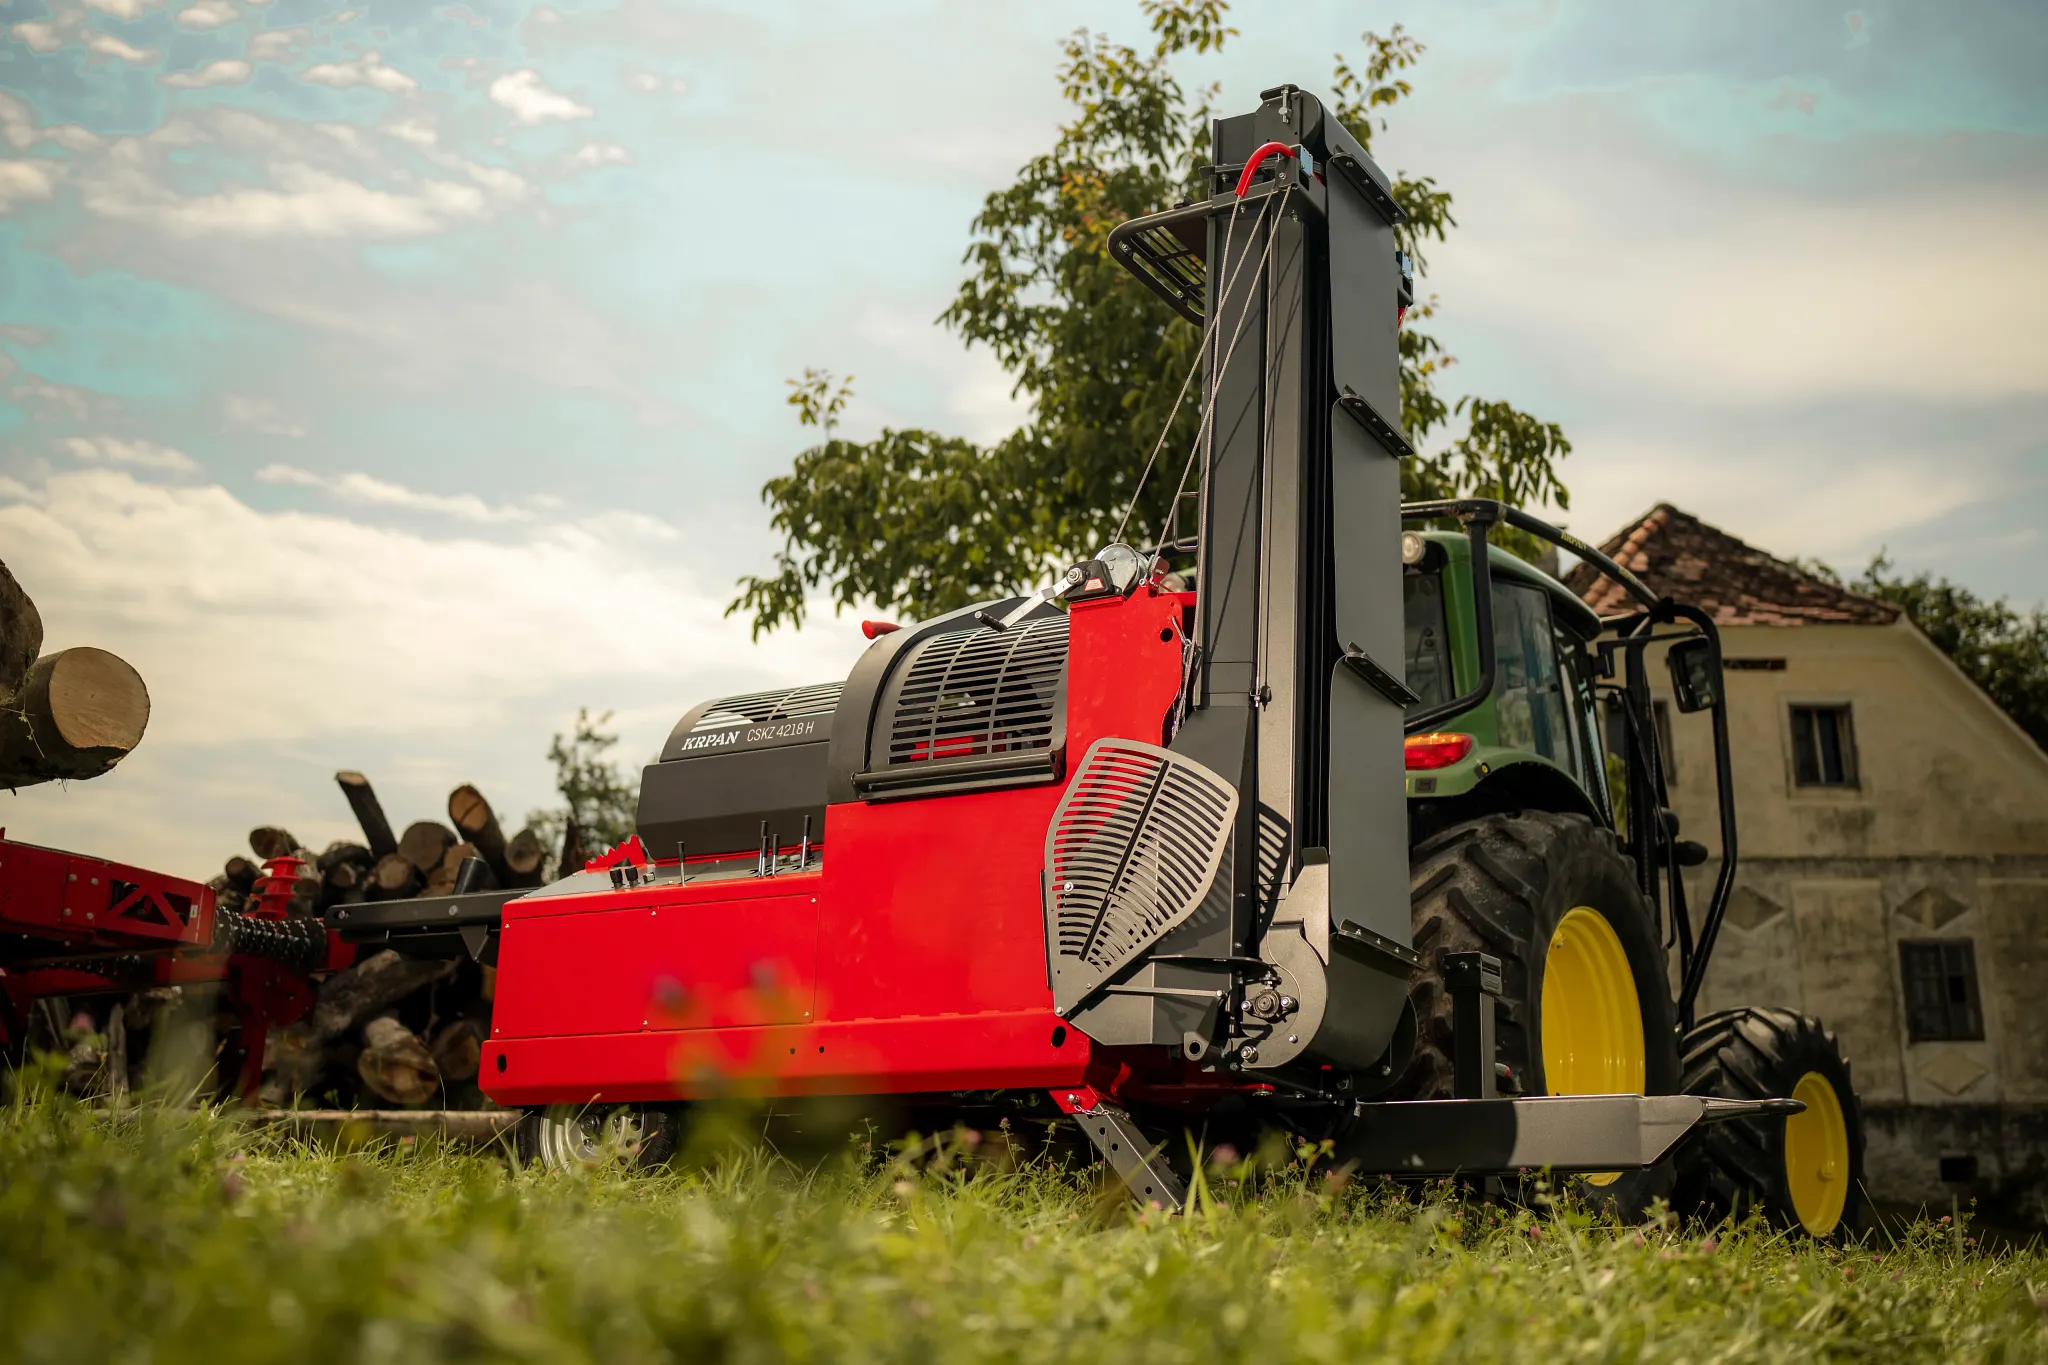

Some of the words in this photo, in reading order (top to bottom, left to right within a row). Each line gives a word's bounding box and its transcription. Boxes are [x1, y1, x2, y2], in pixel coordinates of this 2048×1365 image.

[681, 731, 740, 751] KRPAN
[747, 726, 775, 742] CSKZ
[776, 722, 803, 737] 4218
[805, 721, 815, 734] H
